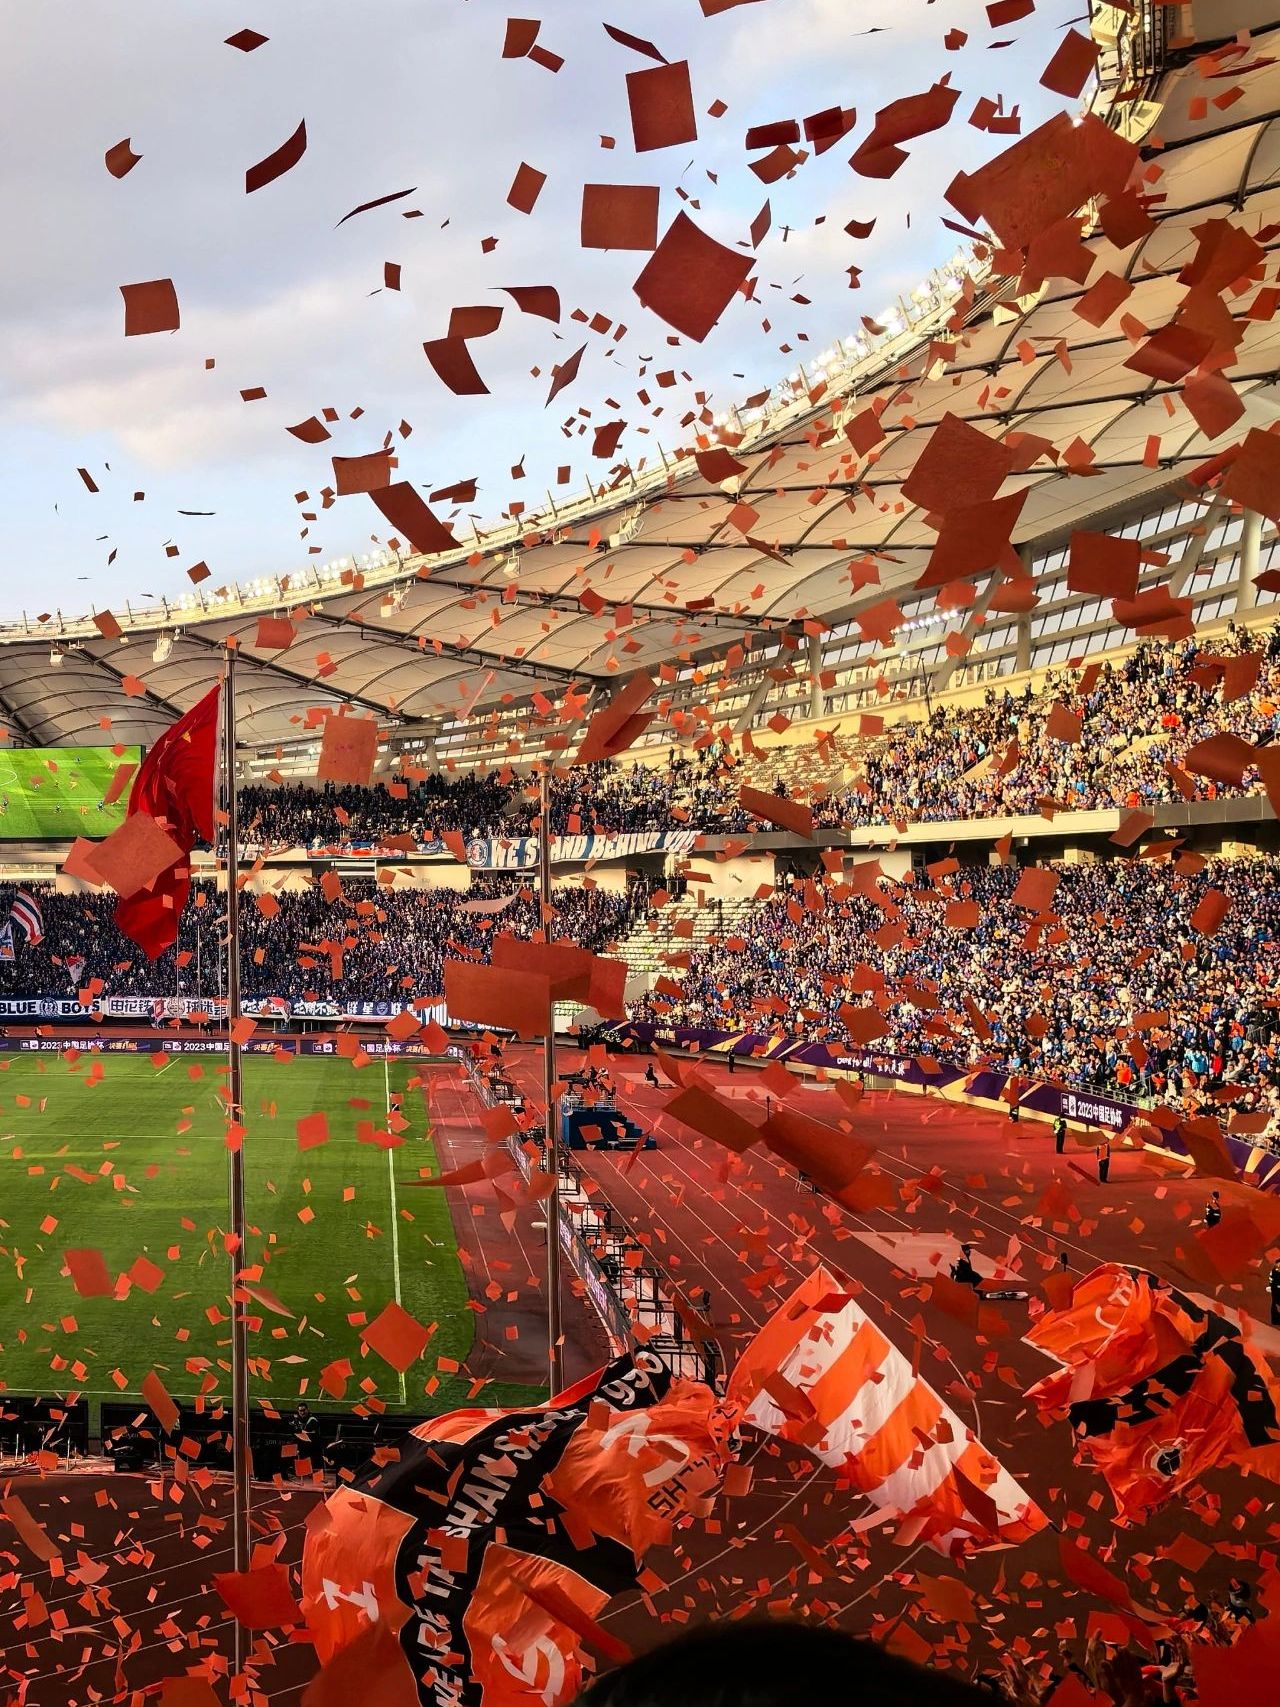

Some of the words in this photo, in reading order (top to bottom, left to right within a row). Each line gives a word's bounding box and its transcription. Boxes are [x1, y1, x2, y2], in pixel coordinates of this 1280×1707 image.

[491, 838, 521, 867] WE
[525, 834, 588, 866] SAND
[184, 1041, 249, 1051] 2023中国足杯
